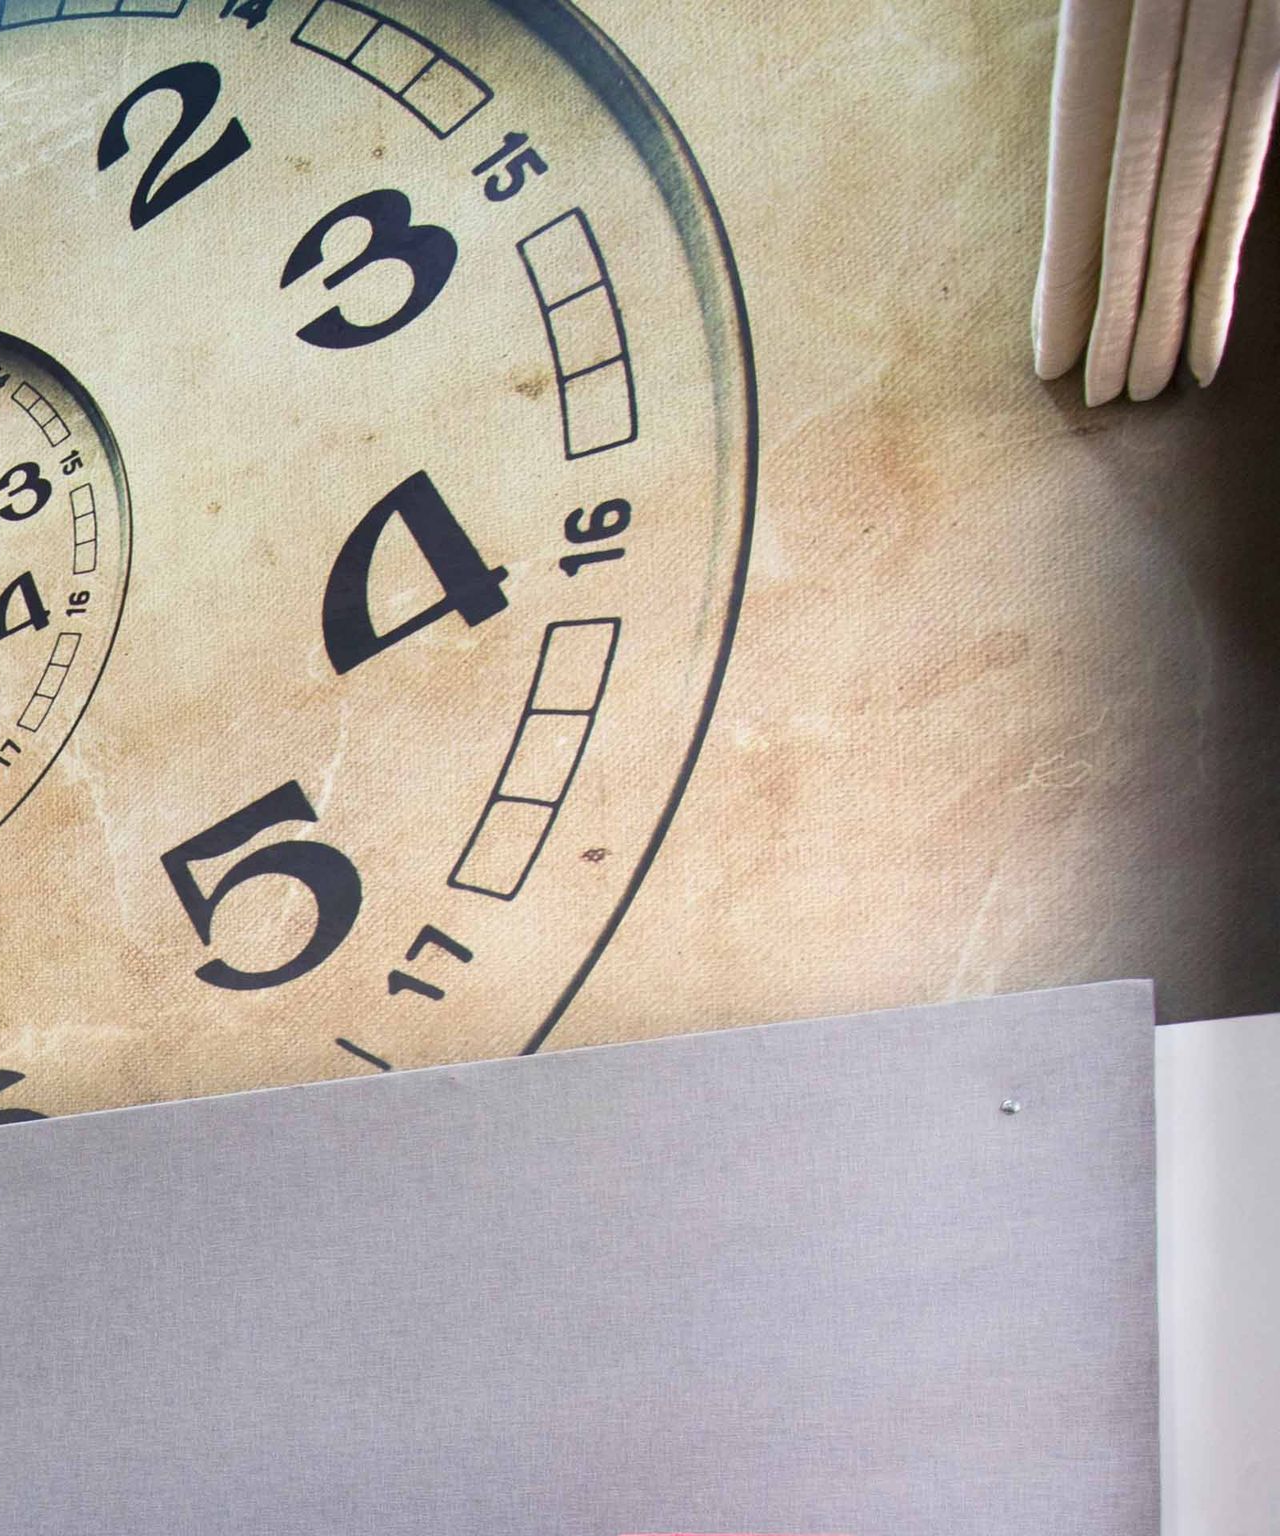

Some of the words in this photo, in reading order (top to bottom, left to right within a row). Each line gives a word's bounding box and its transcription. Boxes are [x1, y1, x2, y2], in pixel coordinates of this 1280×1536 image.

[97, 61, 251, 230] 2
[472, 132, 548, 201] 15
[280, 189, 458, 349] 3
[60, 450, 83, 475] 15
[322, 470, 508, 675] 4
[559, 498, 631, 577] 16
[66, 591, 90, 617] 16
[160, 780, 363, 991] 5
[388, 924, 473, 1001] 17
